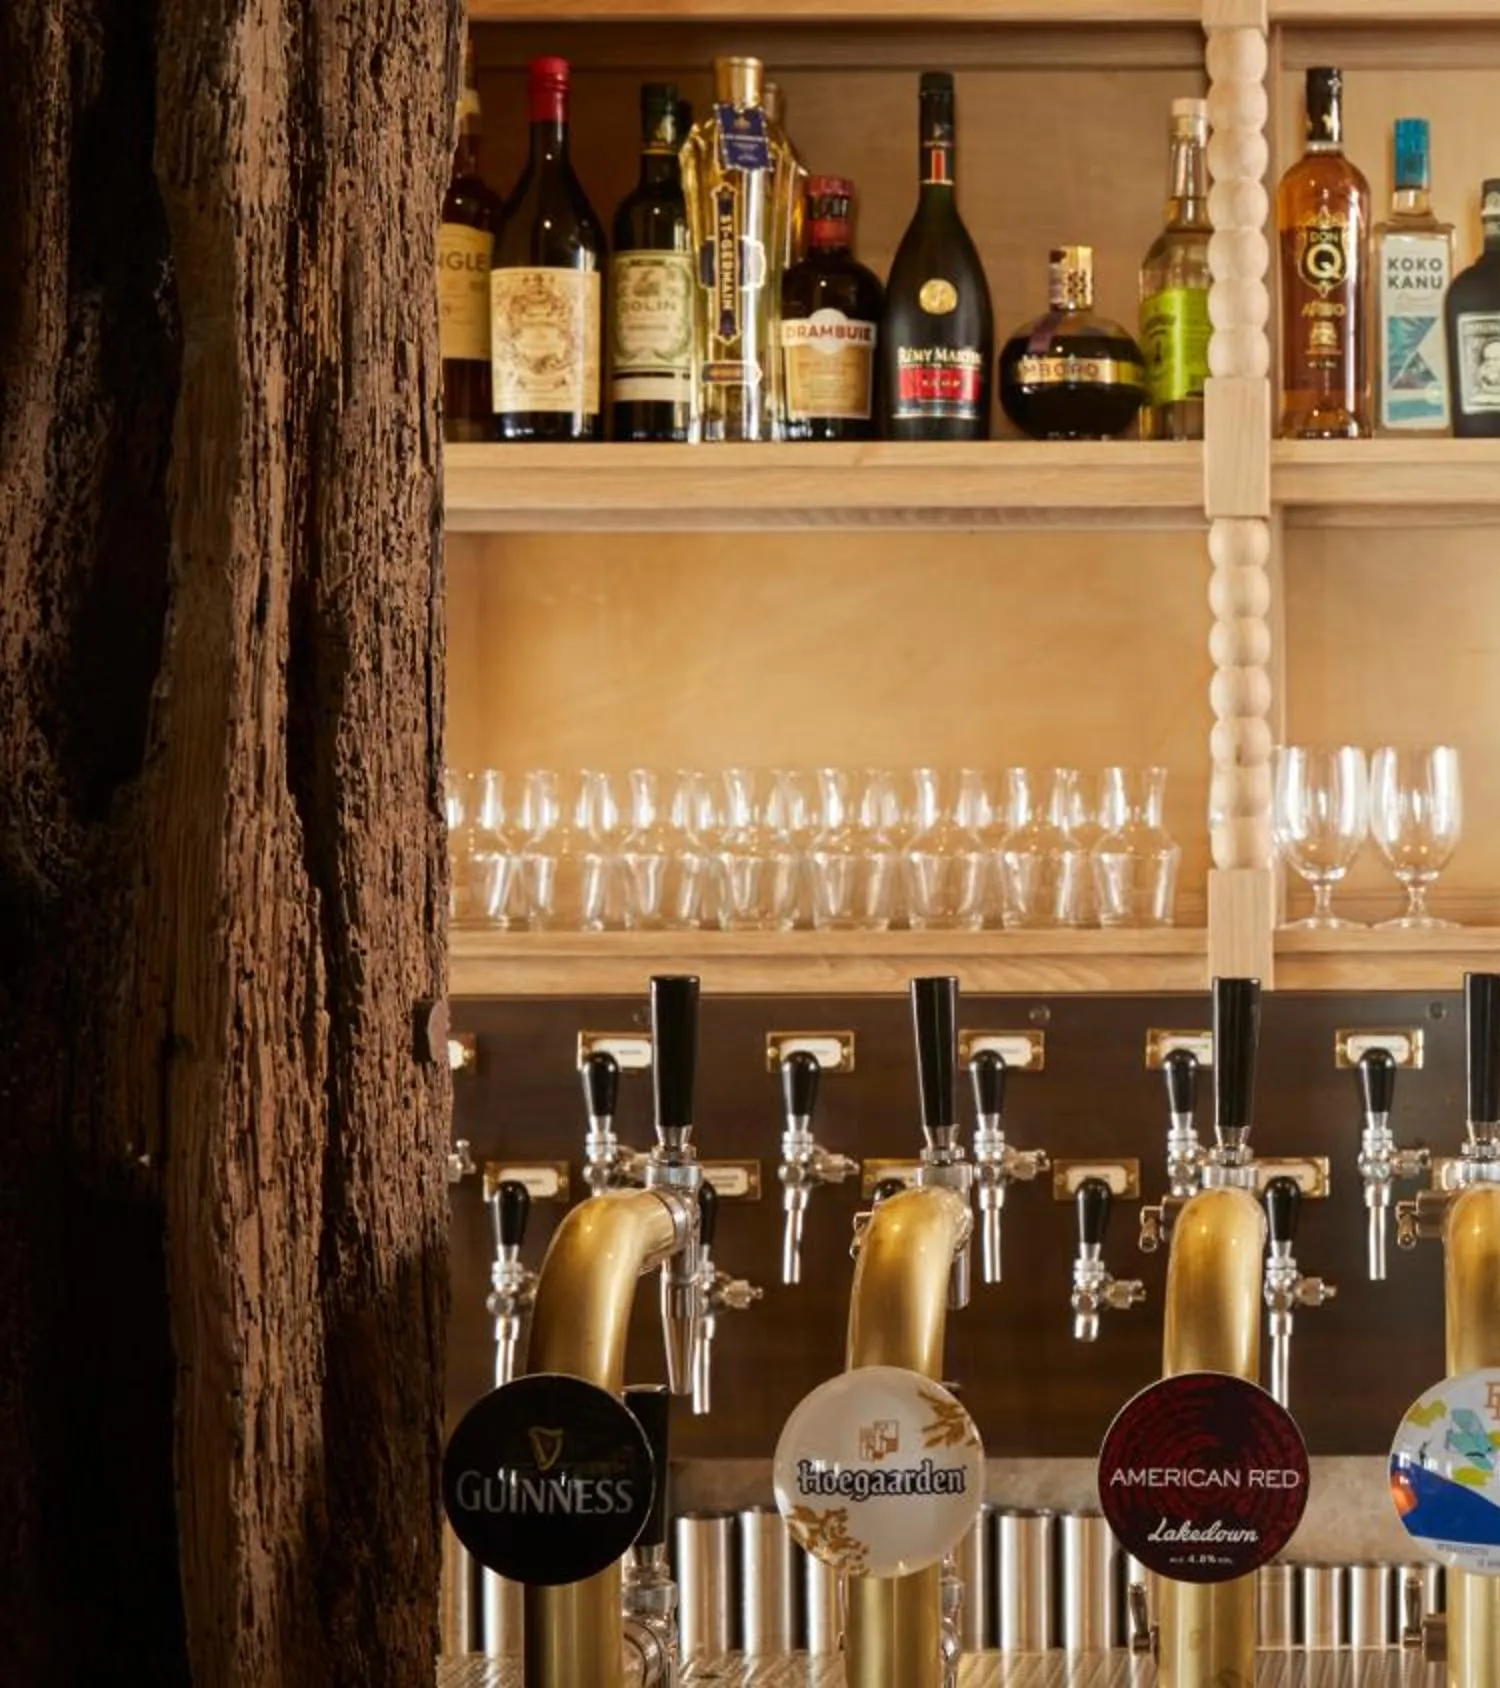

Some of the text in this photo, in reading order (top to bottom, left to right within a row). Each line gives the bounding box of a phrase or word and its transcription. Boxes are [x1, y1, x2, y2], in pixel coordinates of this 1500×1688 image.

[1306, 242, 1343, 280] Q
[1388, 256, 1443, 273] KOKO
[1388, 275, 1443, 291] KANU
[786, 324, 872, 341] DRAMBUIE
[797, 1458, 967, 1502] Hoegaarden
[1109, 1467, 1300, 1489] AMERICAN RED
[456, 1469, 634, 1515] GUINNESS
[1147, 1516, 1259, 1543] Lakedown
